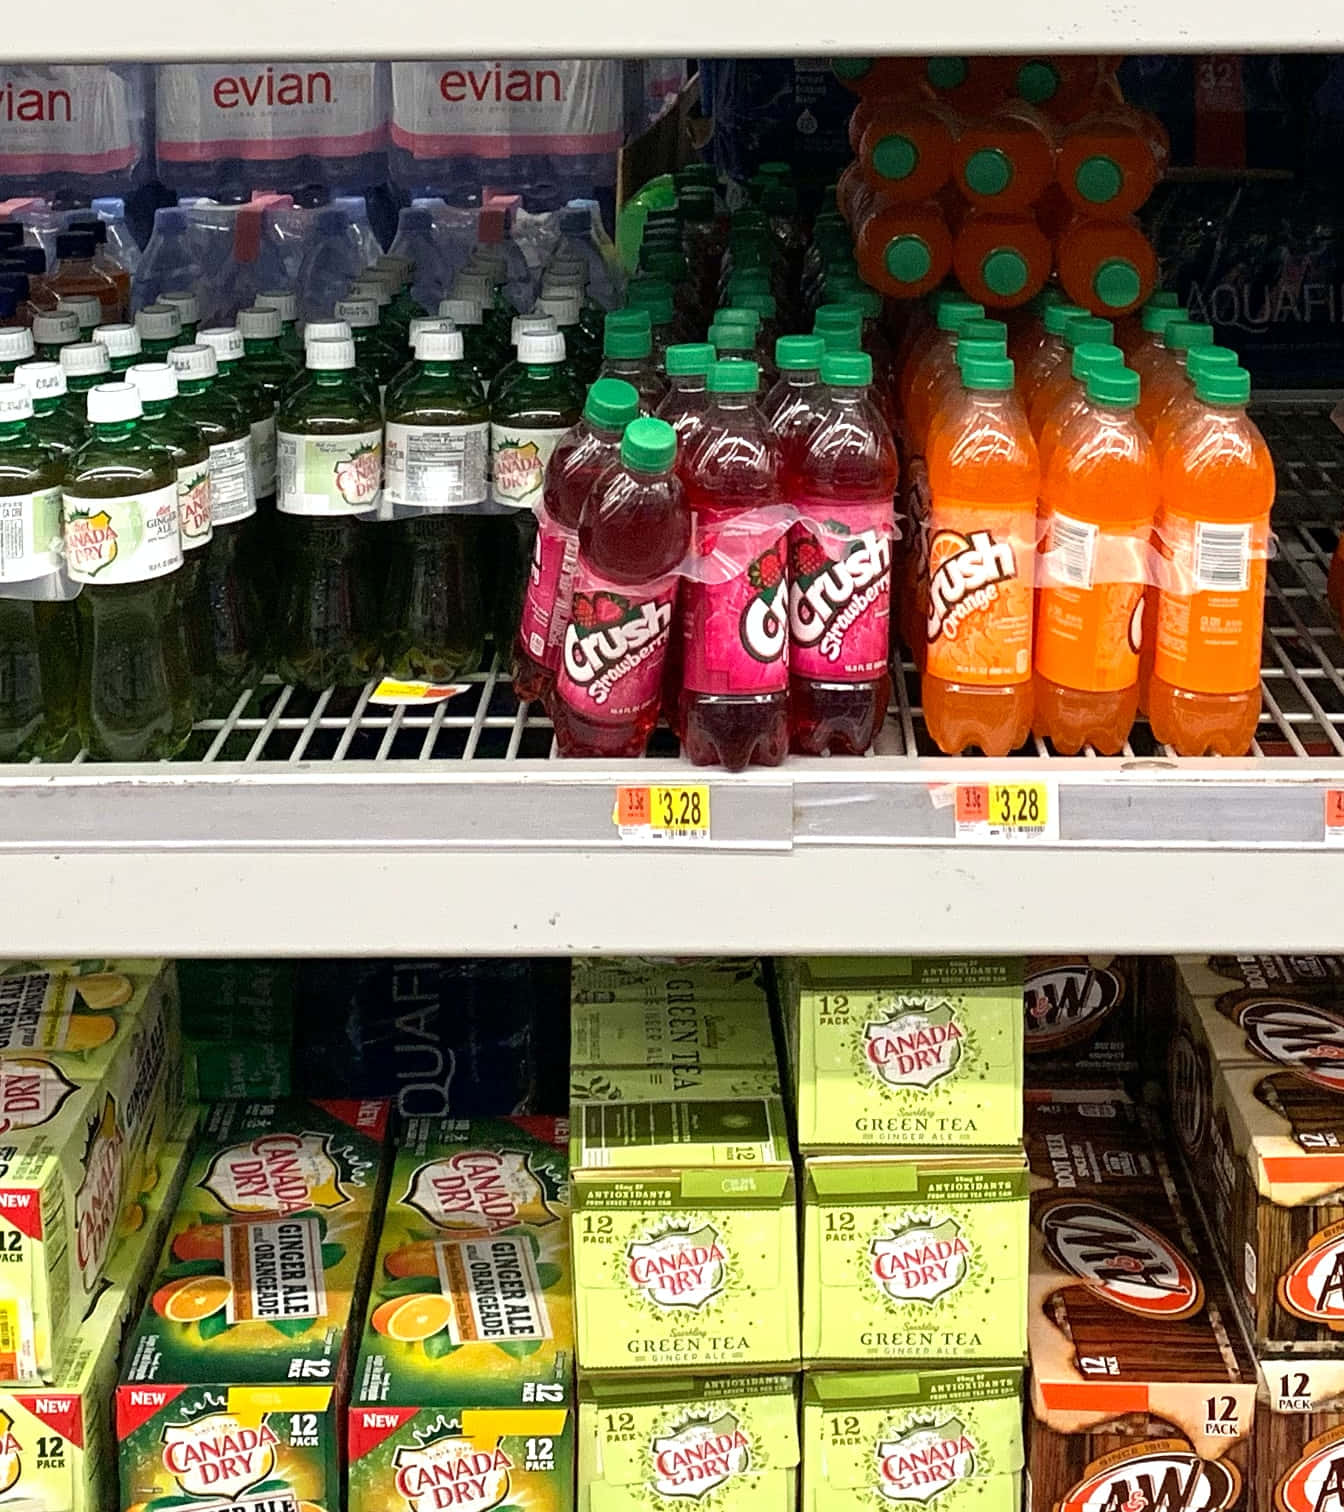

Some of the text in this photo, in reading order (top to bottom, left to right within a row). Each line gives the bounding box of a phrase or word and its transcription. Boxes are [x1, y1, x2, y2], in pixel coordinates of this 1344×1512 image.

[214, 68, 332, 109] evian
[440, 65, 562, 103] evian
[791, 533, 890, 640] Crush
[819, 573, 890, 662] Strawberry
[943, 583, 998, 639] Orange
[563, 599, 672, 677] Crush
[587, 633, 672, 704] Strawberry
[819, 997, 850, 1015] 12
[867, 1023, 962, 1067] CANADA
[897, 1046, 945, 1075] DRY
[855, 1117, 977, 1132] GREEN TEA
[878, 1133, 925, 1141] GINGER
[165, 1429, 279, 1473] CANADA
[199, 1454, 253, 1487] DRY
